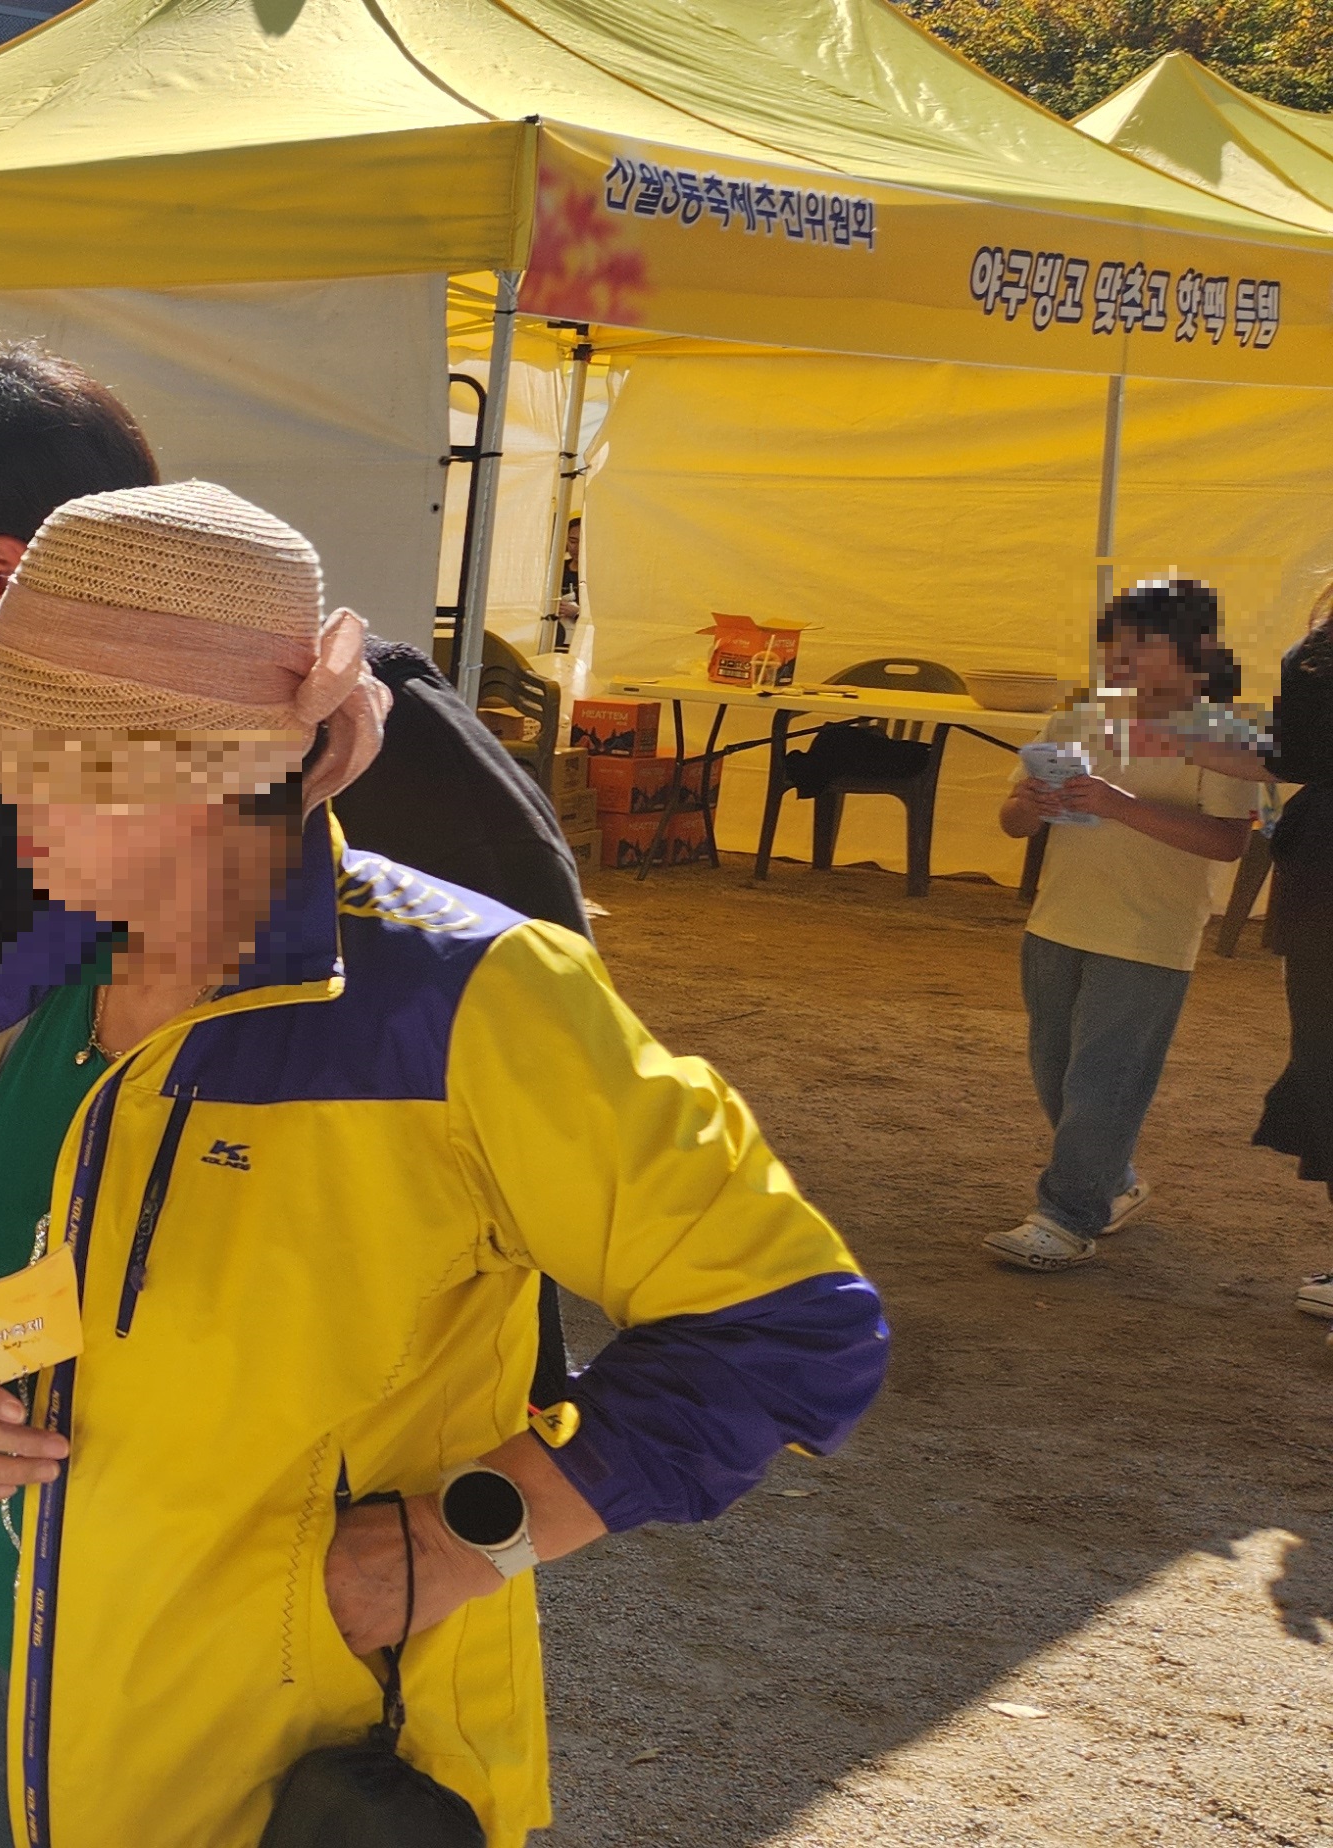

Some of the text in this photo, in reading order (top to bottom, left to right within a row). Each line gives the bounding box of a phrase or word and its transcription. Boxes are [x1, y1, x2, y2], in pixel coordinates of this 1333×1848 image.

[605, 157, 875, 250] 신월3동축제추진위원회
[971, 246, 1280, 349] 야구빙고 맞추고 핫팩 득템
